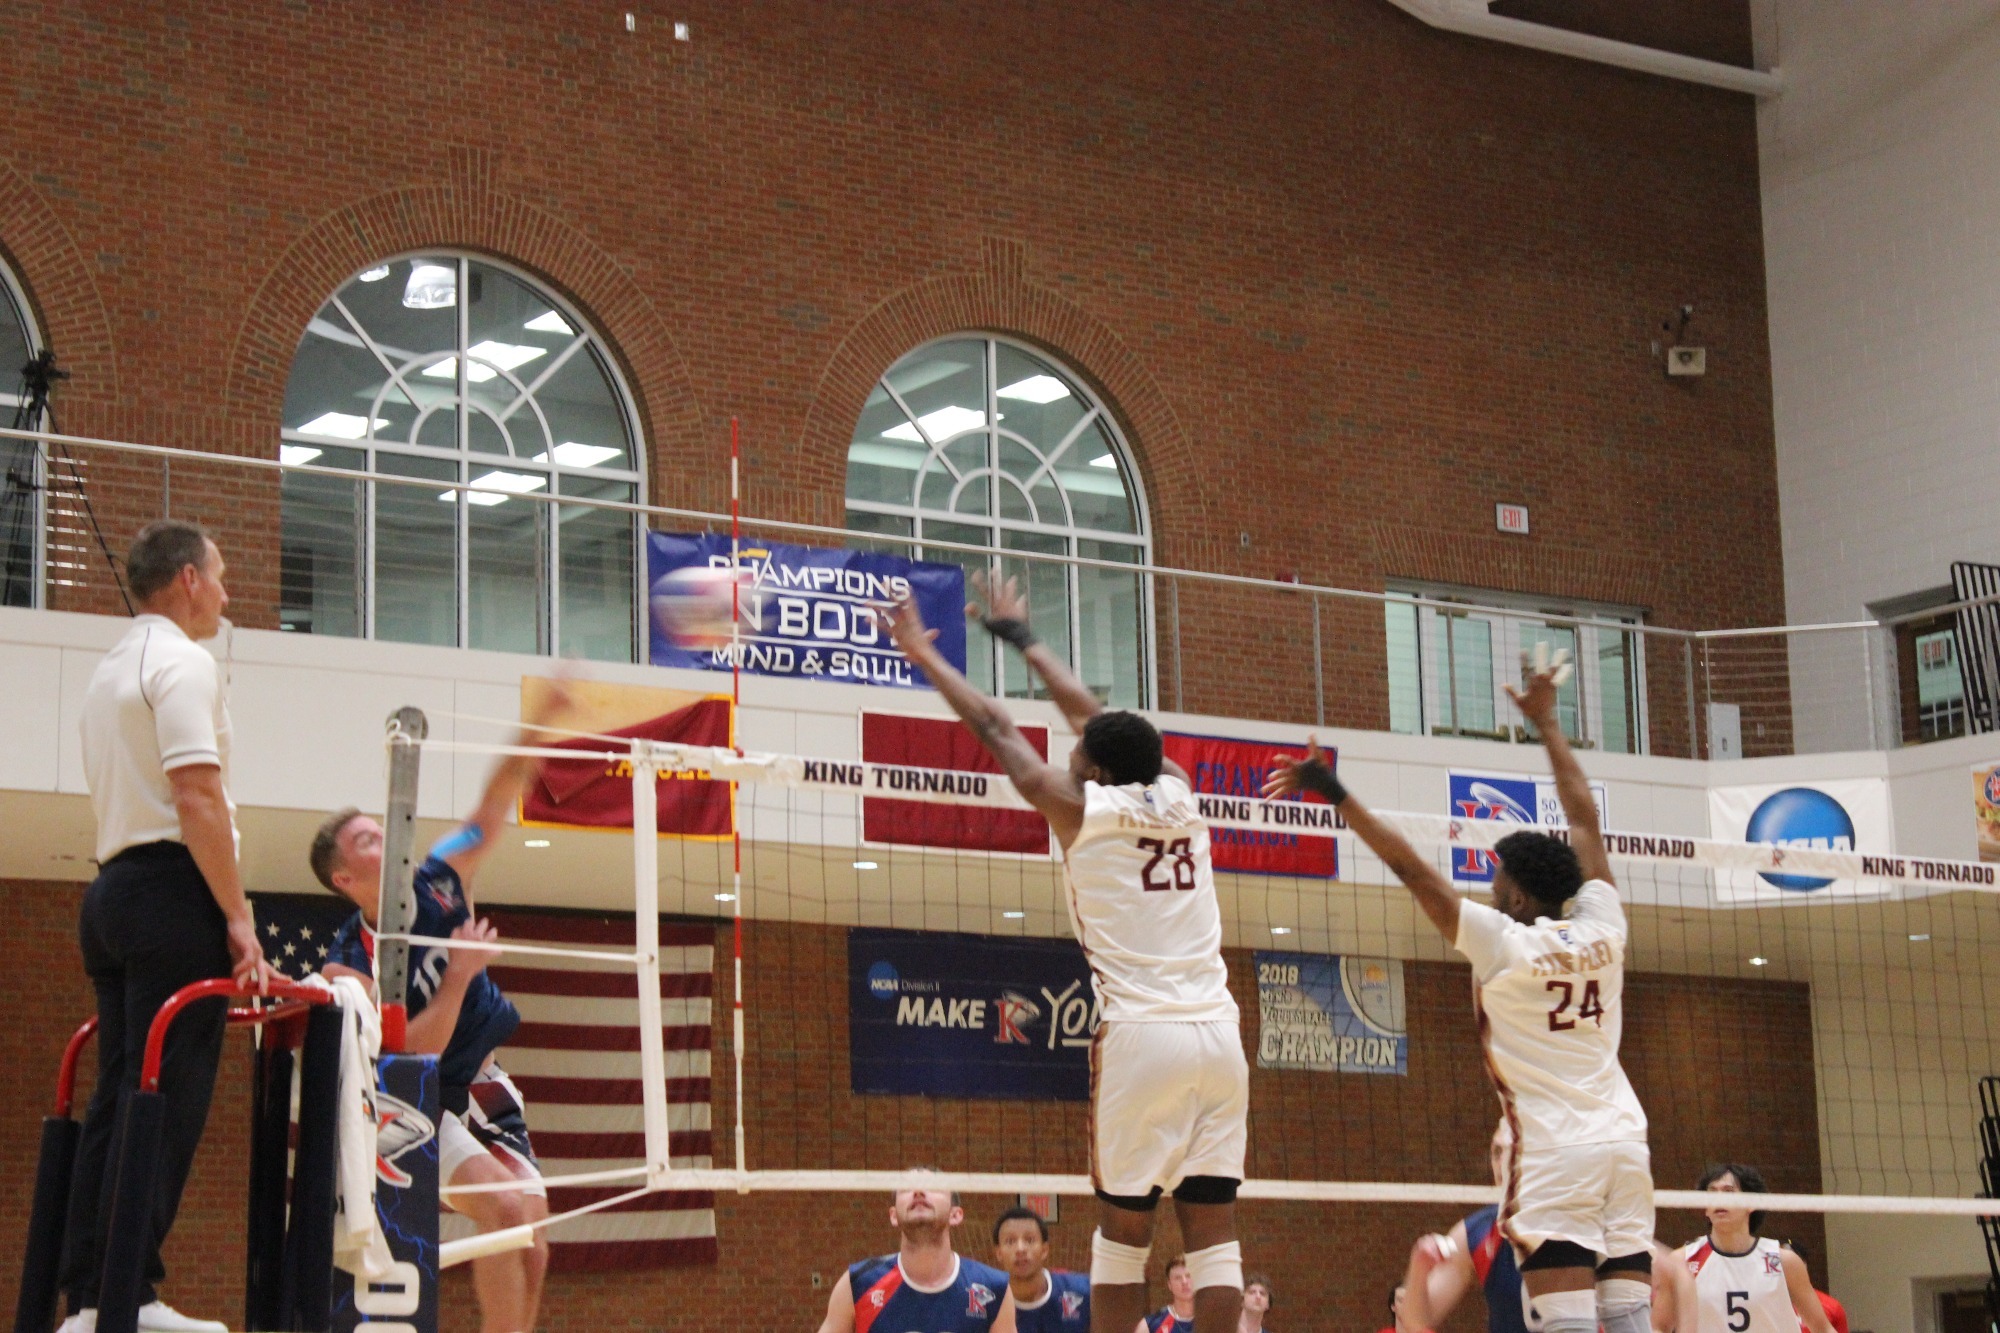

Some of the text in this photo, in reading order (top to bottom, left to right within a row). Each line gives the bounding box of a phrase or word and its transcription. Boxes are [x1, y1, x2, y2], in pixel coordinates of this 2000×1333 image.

[1502, 508, 1522, 528] EXIT
[712, 642, 795, 673] MIND
[801, 650, 824, 675] &
[803, 760, 987, 797] KING TORNADO
[1196, 762, 1303, 801] FRAN
[1198, 797, 1250, 821] KING
[1259, 802, 1347, 829] TORNAD
[1603, 834, 1695, 859] TORNADO
[1137, 837, 1196, 891] 28
[1862, 856, 1994, 885] KING TORNADO
[1258, 963, 1299, 985] 2018
[896, 996, 987, 1029] MAKE
[1546, 980, 1604, 1031] 24
[1261, 1027, 1398, 1067] CHAMPION
[1726, 1291, 1751, 1332] 5
